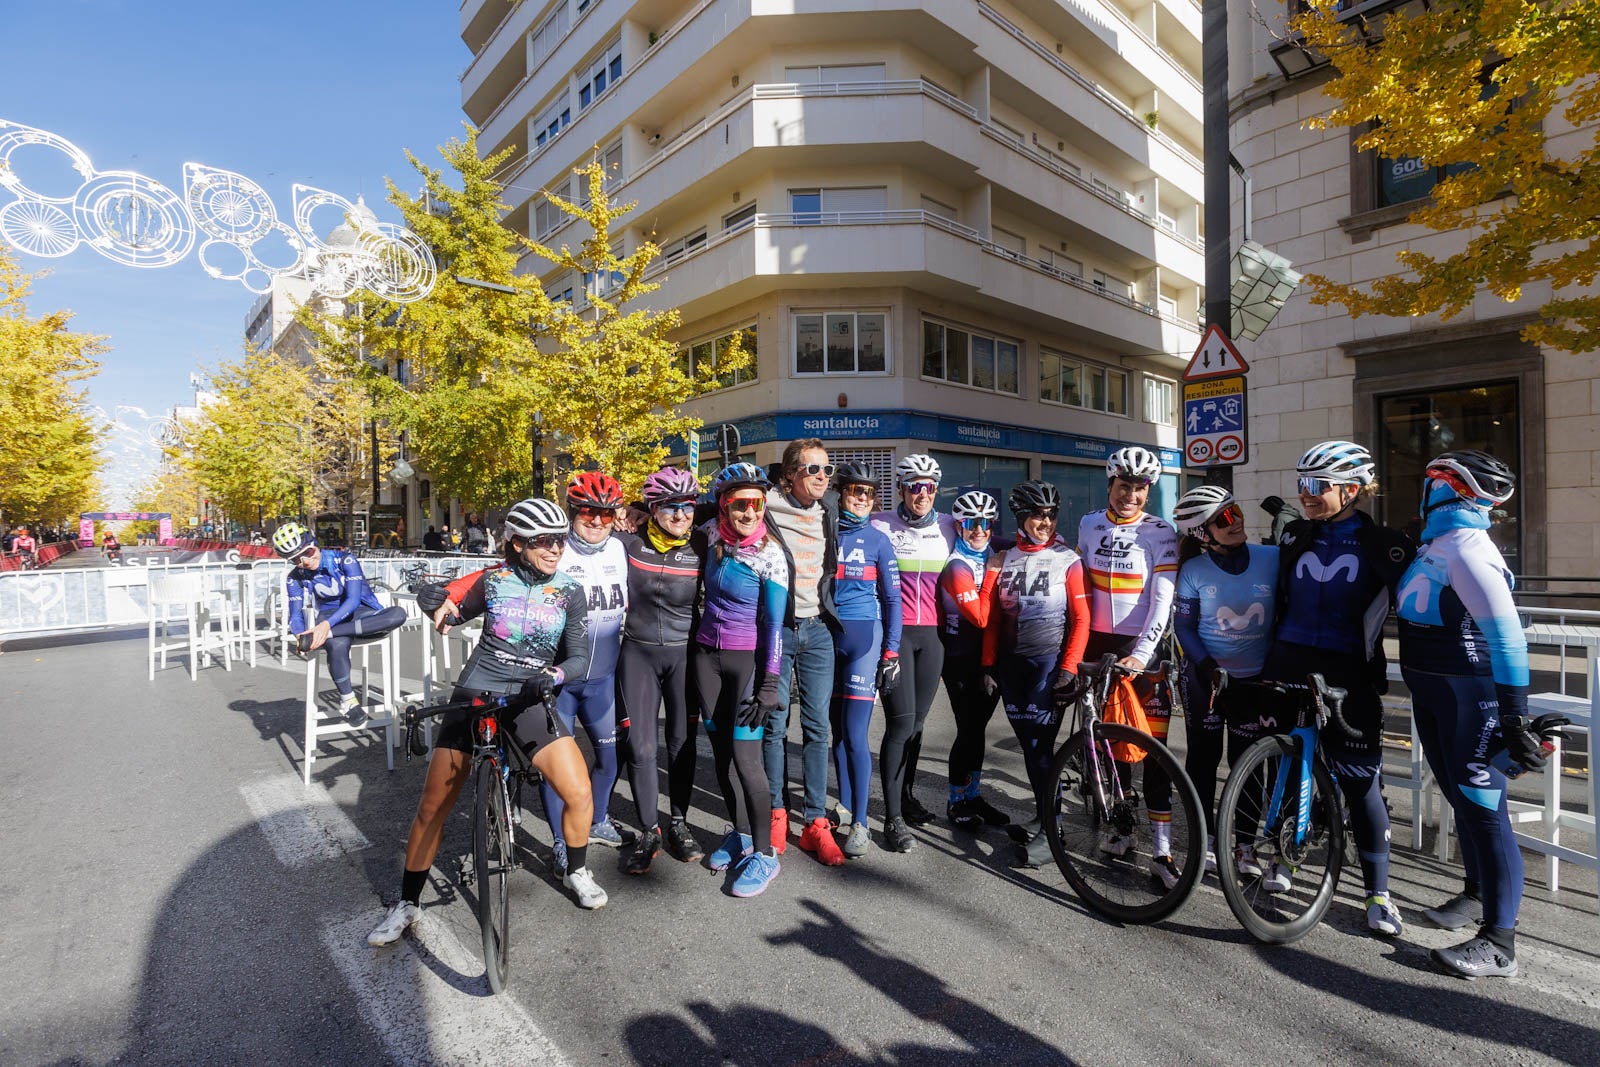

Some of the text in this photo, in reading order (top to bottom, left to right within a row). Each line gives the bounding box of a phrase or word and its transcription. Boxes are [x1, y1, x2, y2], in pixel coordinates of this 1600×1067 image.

[1186, 386, 1241, 400] RESIDENCIAL
[1201, 381, 1225, 390] ZONA
[803, 416, 879, 430] santalucía
[1192, 446, 1208, 456] 20
[999, 571, 1051, 597] FAA
[587, 584, 625, 611] AA
[956, 589, 980, 605] FAA
[1464, 641, 1479, 663] BIKE
[1474, 716, 1497, 758] Movistar
[1297, 778, 1310, 833] CANYON
